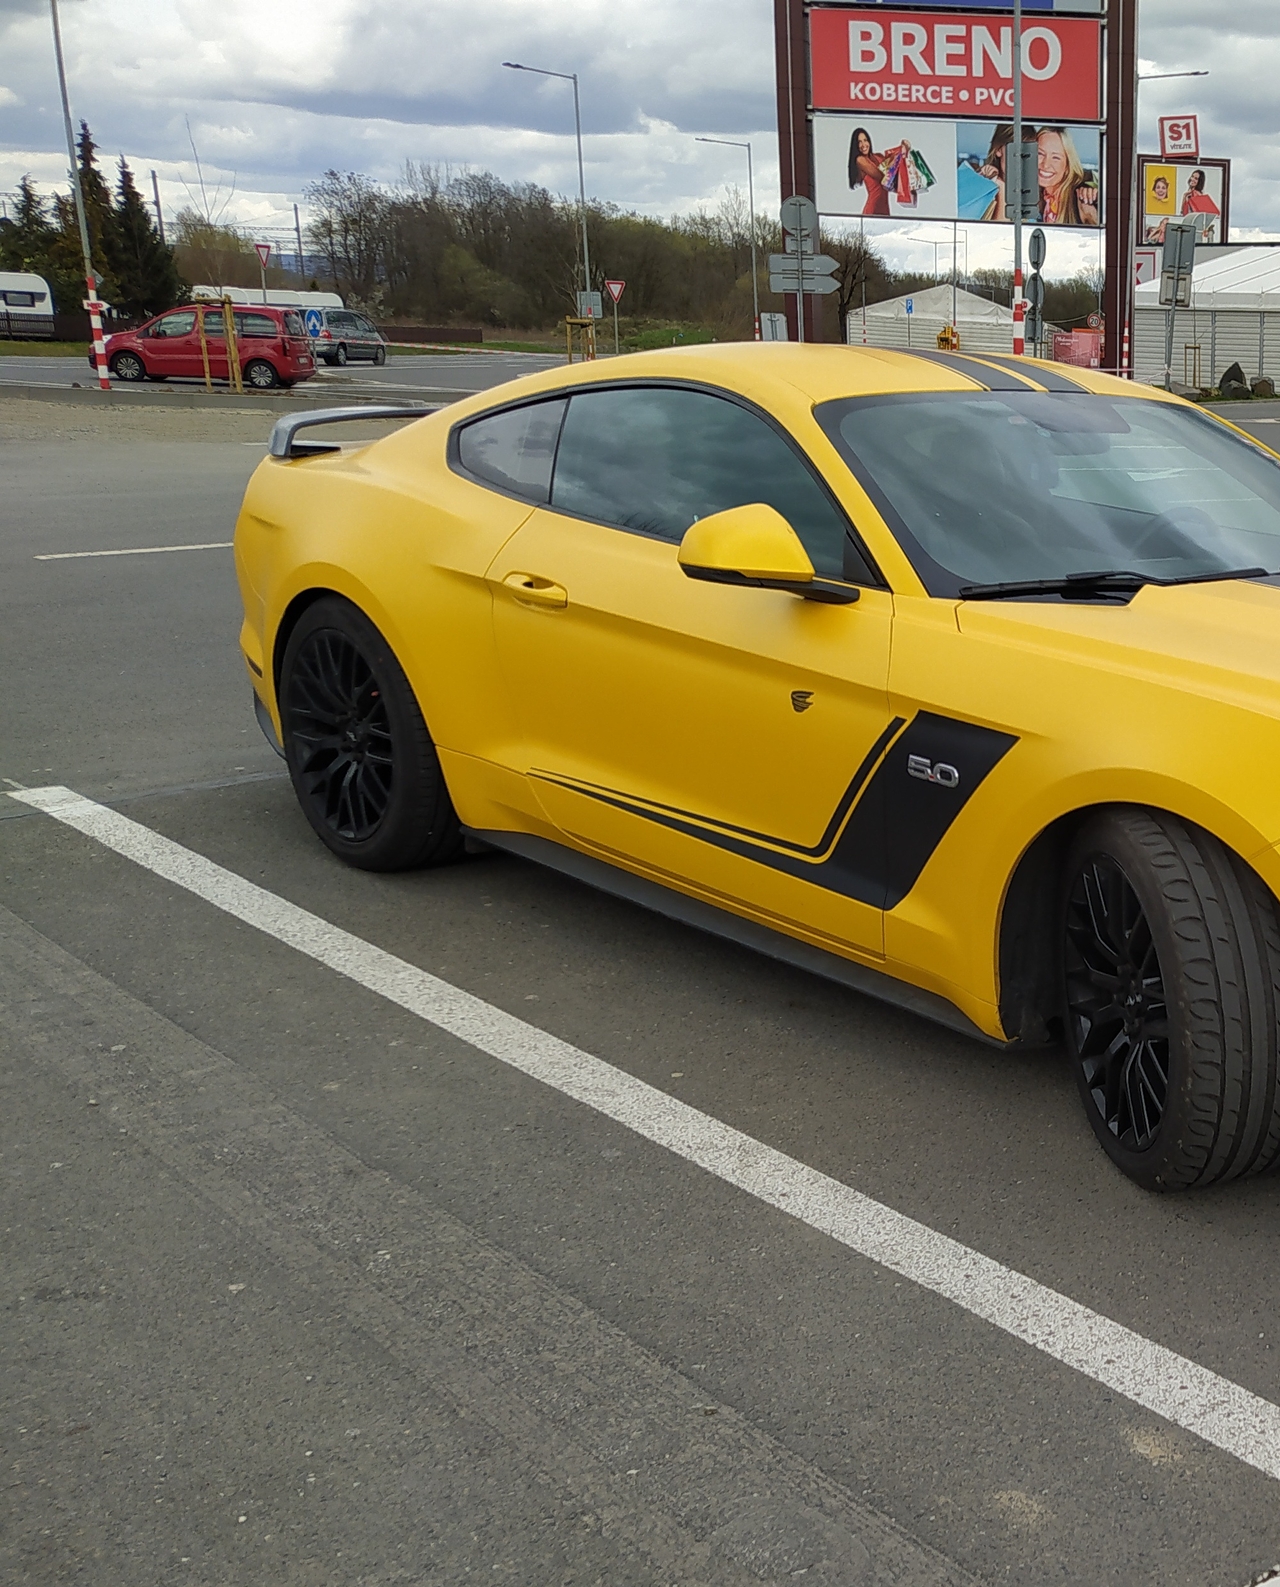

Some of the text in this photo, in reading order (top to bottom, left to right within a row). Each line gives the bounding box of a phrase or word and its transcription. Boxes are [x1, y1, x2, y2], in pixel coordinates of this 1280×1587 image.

[848, 20, 1062, 81] BRENO
[850, 81, 954, 104] KOBERCE
[1168, 122, 1192, 142] S1
[1091, 318, 1098, 326] 20
[907, 753, 960, 788] 5.0
